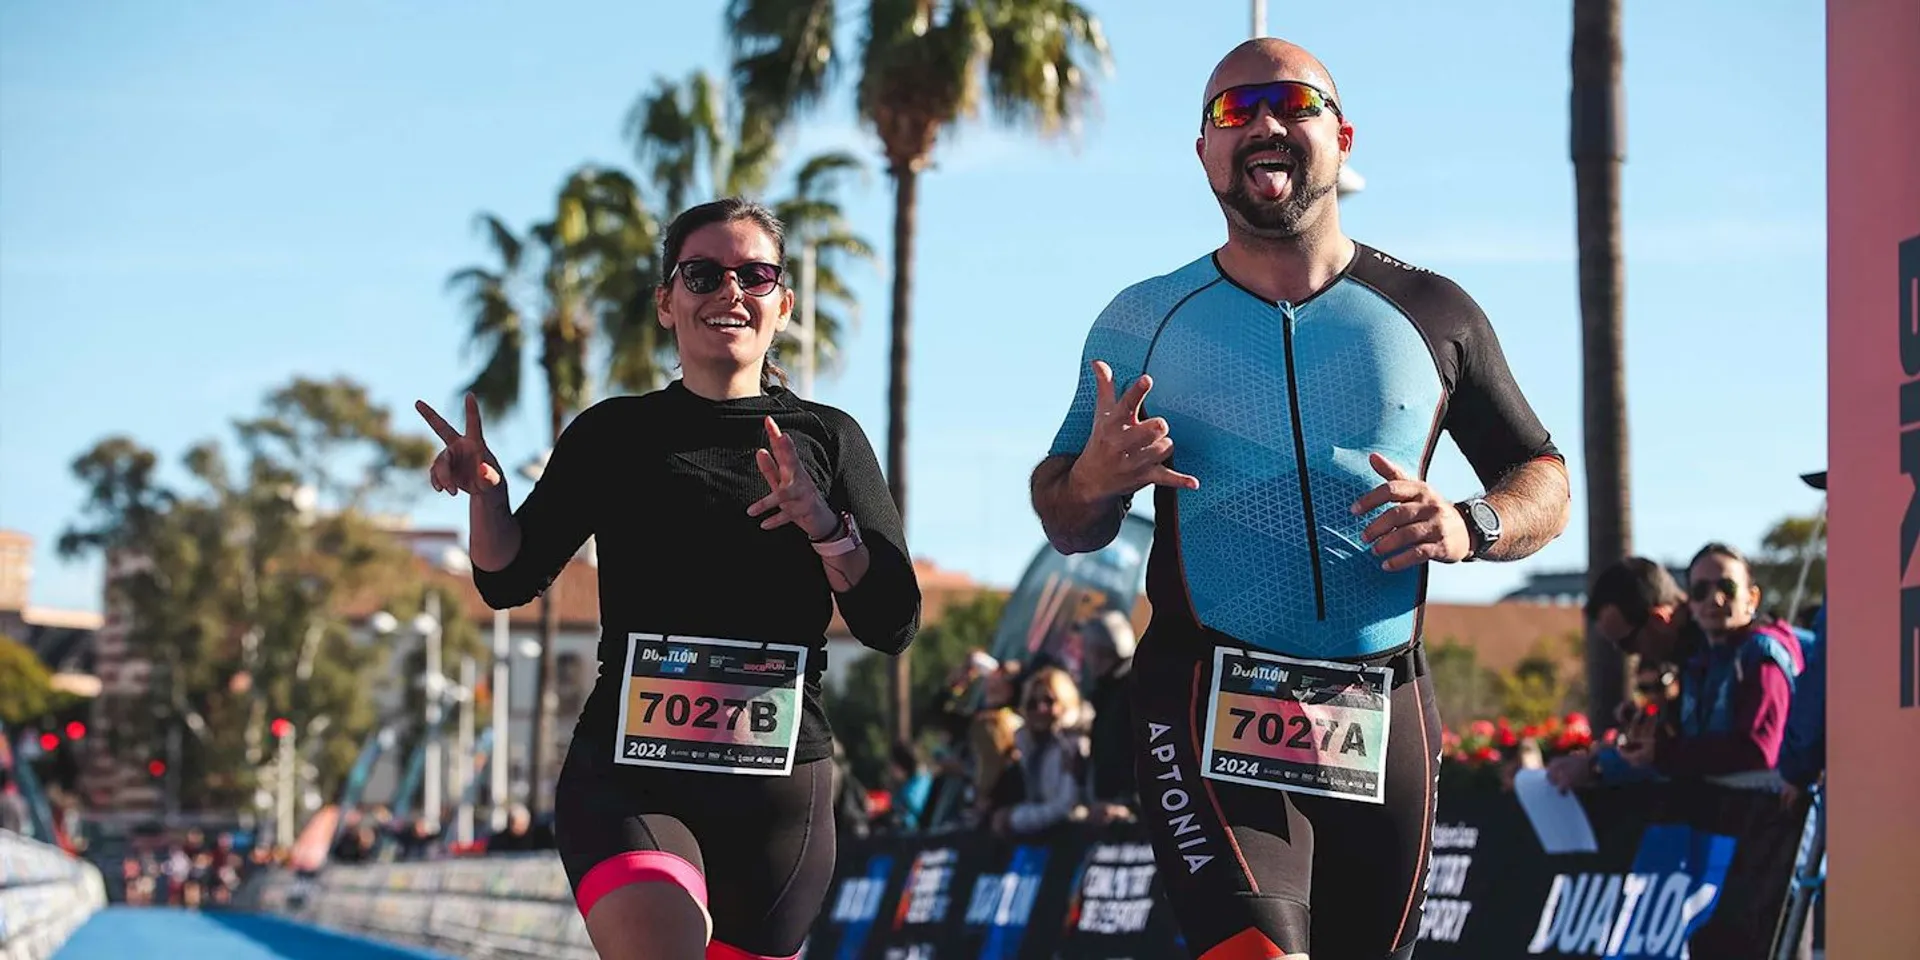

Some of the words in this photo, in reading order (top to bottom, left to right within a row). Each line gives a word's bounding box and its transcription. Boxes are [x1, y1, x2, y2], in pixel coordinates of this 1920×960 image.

[640, 692, 777, 732] 7027B
[627, 742, 667, 758] 2024
[1229, 708, 1367, 757] 7027A
[1215, 757, 1259, 776] 2024
[1148, 722, 1215, 874] APTONIA
